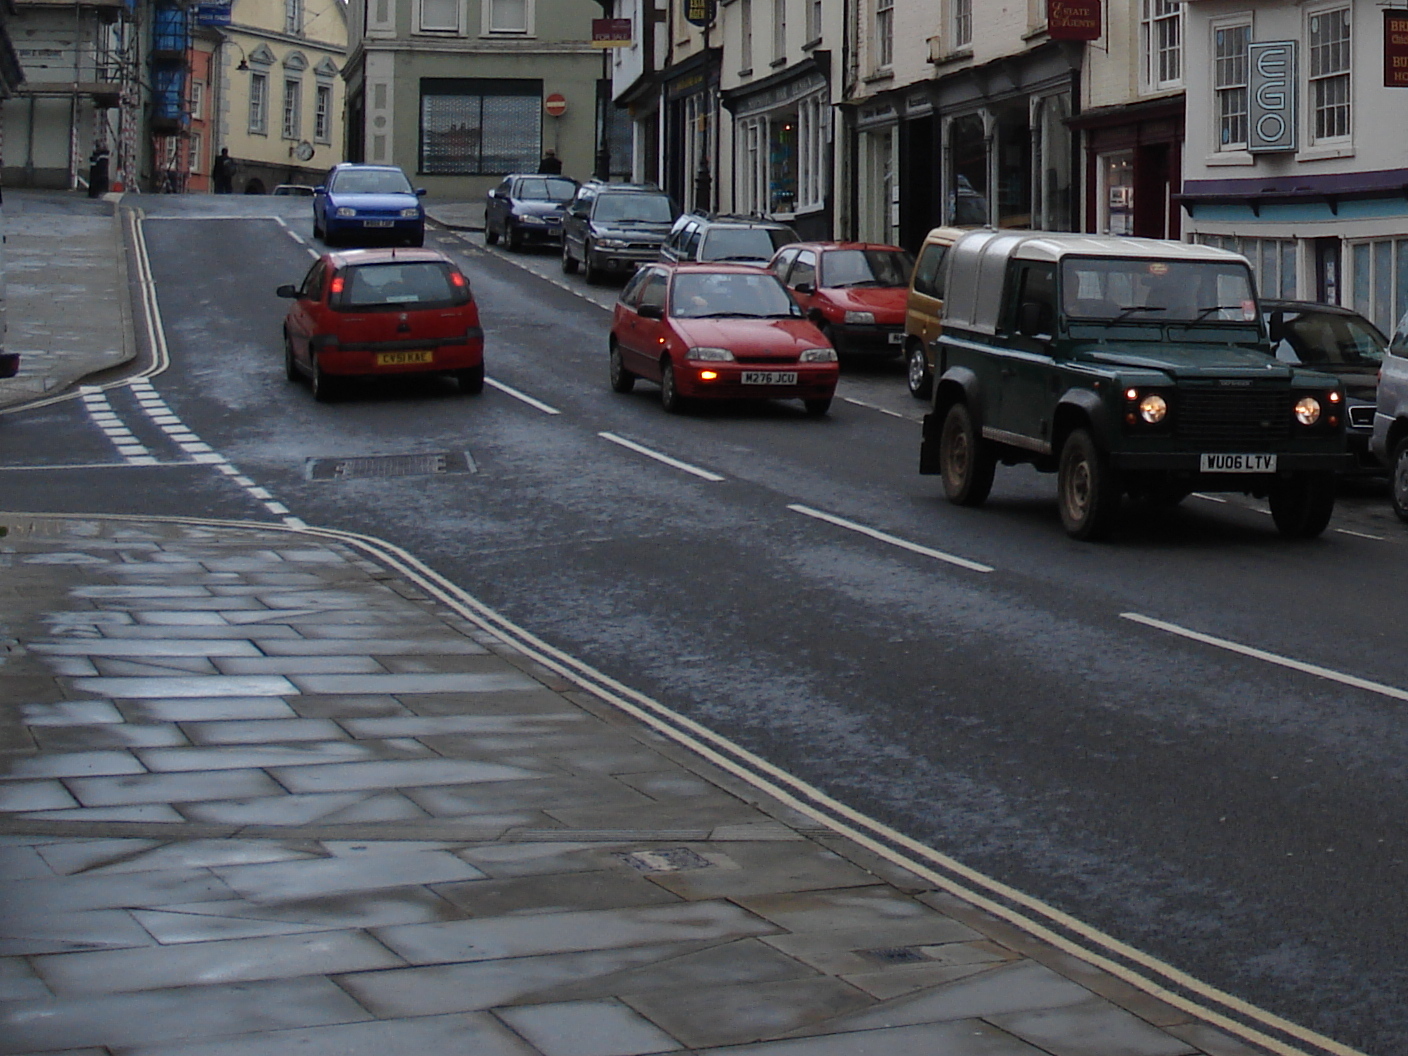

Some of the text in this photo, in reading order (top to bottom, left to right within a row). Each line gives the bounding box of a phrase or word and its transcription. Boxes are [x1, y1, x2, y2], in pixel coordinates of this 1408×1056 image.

[1256, 48, 1286, 142] EGO
[745, 373, 795, 383] M276 JCU
[1207, 455, 1272, 469] WU06 LTV
